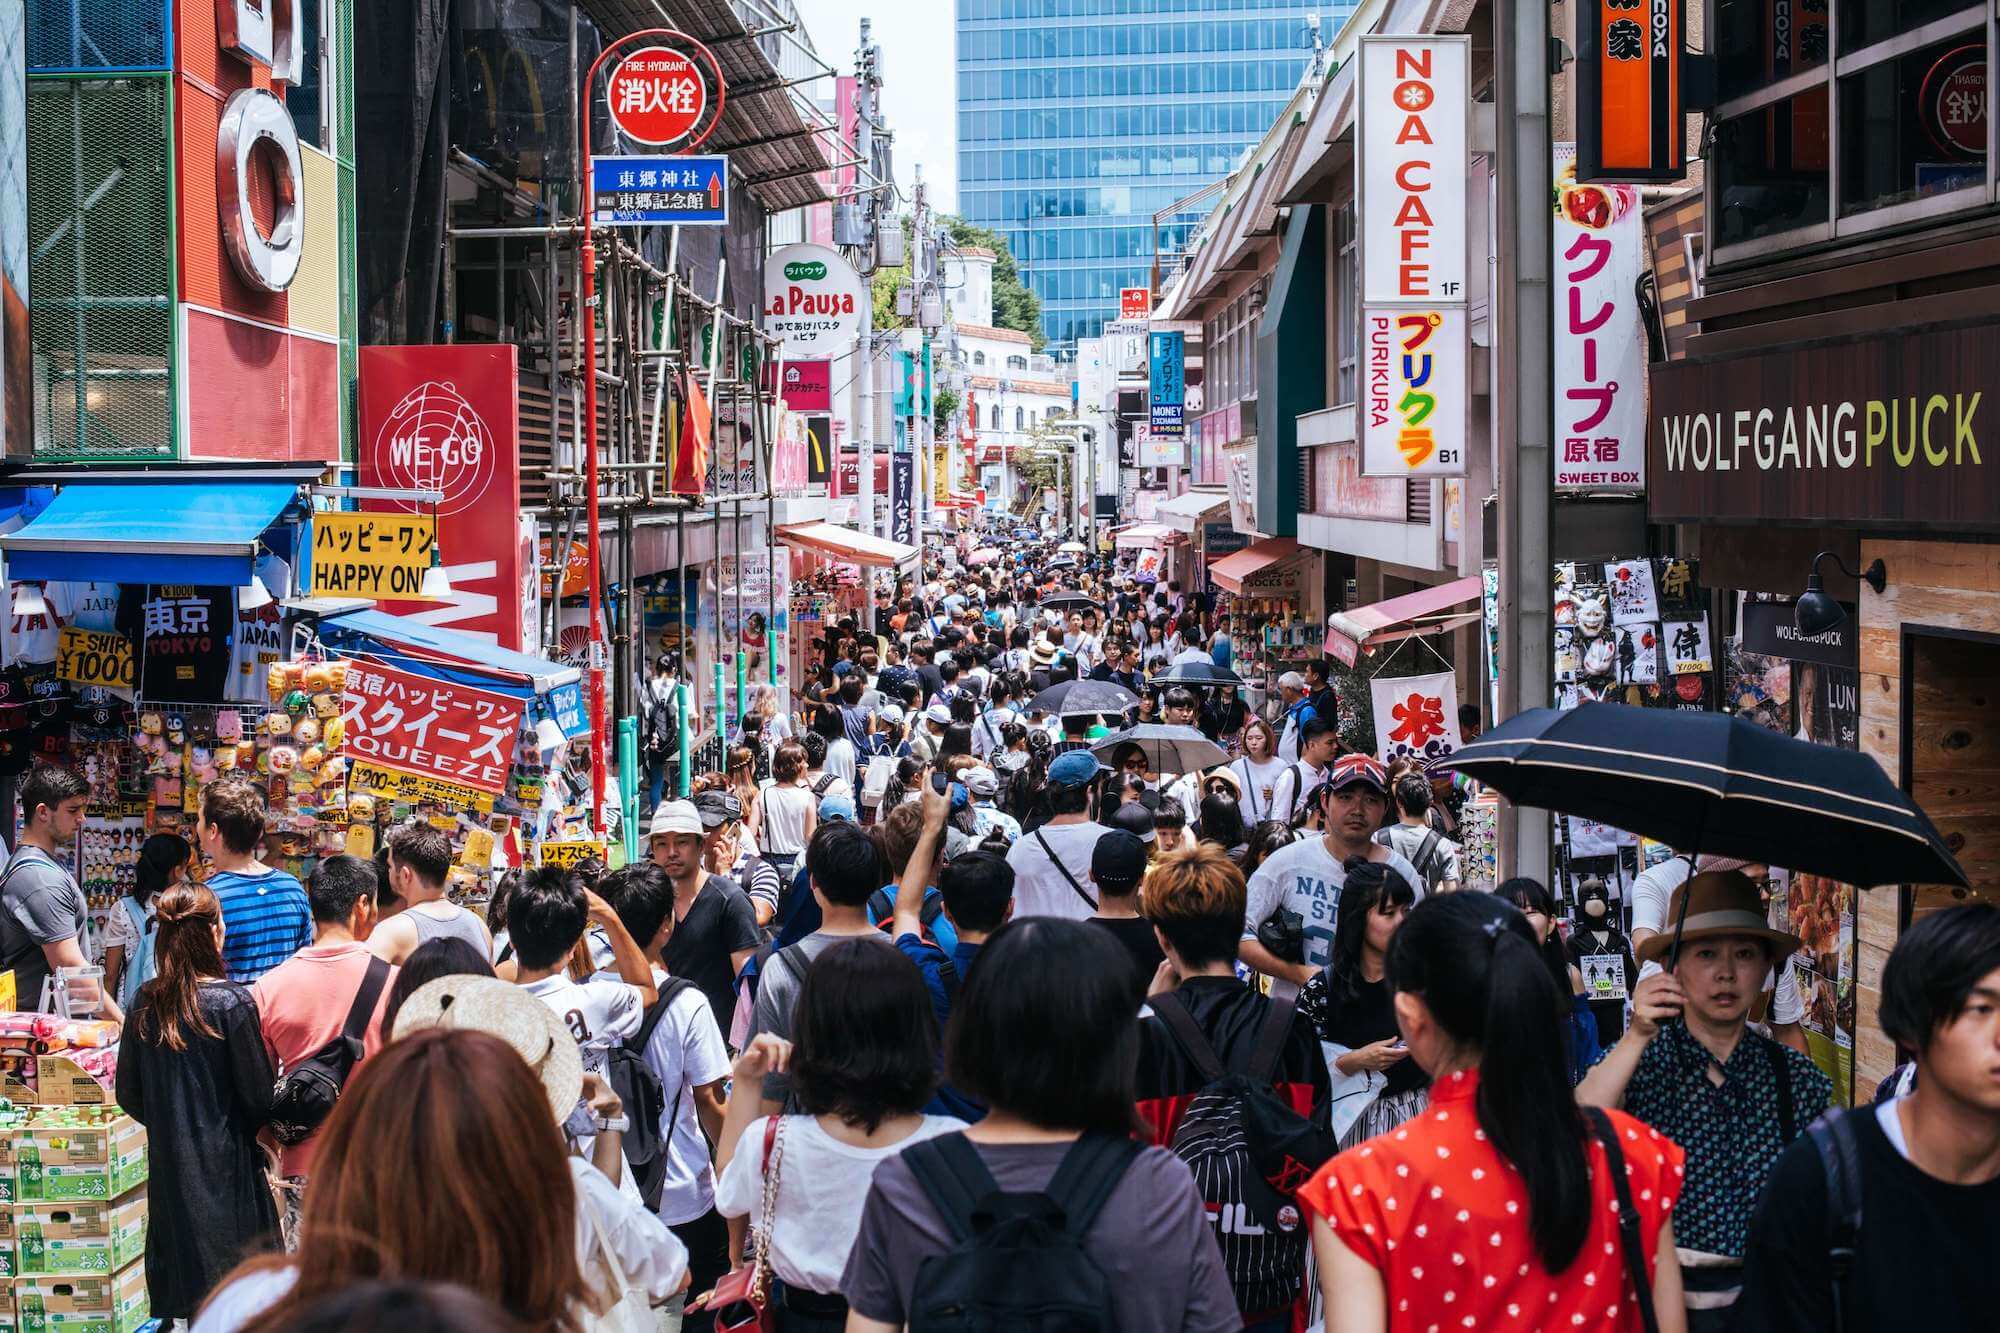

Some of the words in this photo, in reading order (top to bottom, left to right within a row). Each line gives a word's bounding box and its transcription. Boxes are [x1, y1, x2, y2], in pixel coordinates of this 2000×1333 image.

[625, 61, 645, 72] FIRE
[648, 61, 688, 72] HYDRANT
[618, 77, 697, 114] 消火栓
[1393, 48, 1435, 145] NOA
[618, 170, 700, 188] 東郷神社
[617, 192, 704, 211] 東郷記念館
[1393, 160, 1435, 297] CAFE
[1441, 282, 1461, 296] 1F
[788, 286, 854, 317] Pausa
[1564, 232, 1619, 434] クレープ
[787, 372, 798, 381] 6F
[1371, 317, 1389, 429] PURIKURA
[1396, 311, 1442, 469] プリクラ
[1152, 406, 1184, 417] MONEY
[1152, 417, 1184, 425] EXCHANGE
[1662, 401, 1858, 472] WOLFGANG
[1865, 391, 1983, 468] PUCK
[1439, 449, 1459, 464] B1
[1563, 437, 1620, 465] 原宿
[1559, 472, 1609, 485] SWEET
[1610, 471, 1640, 484] BOX
[316, 521, 434, 553] ハッピーワン
[314, 563, 384, 591] HAPPY
[141, 596, 211, 637] 東京
[1621, 607, 1645, 616] JAPAN
[147, 636, 213, 656] TOKYO
[342, 690, 514, 767] スクイーズ
[78, 1178, 106, 1196] お茶
[79, 1251, 109, 1270] お茶
